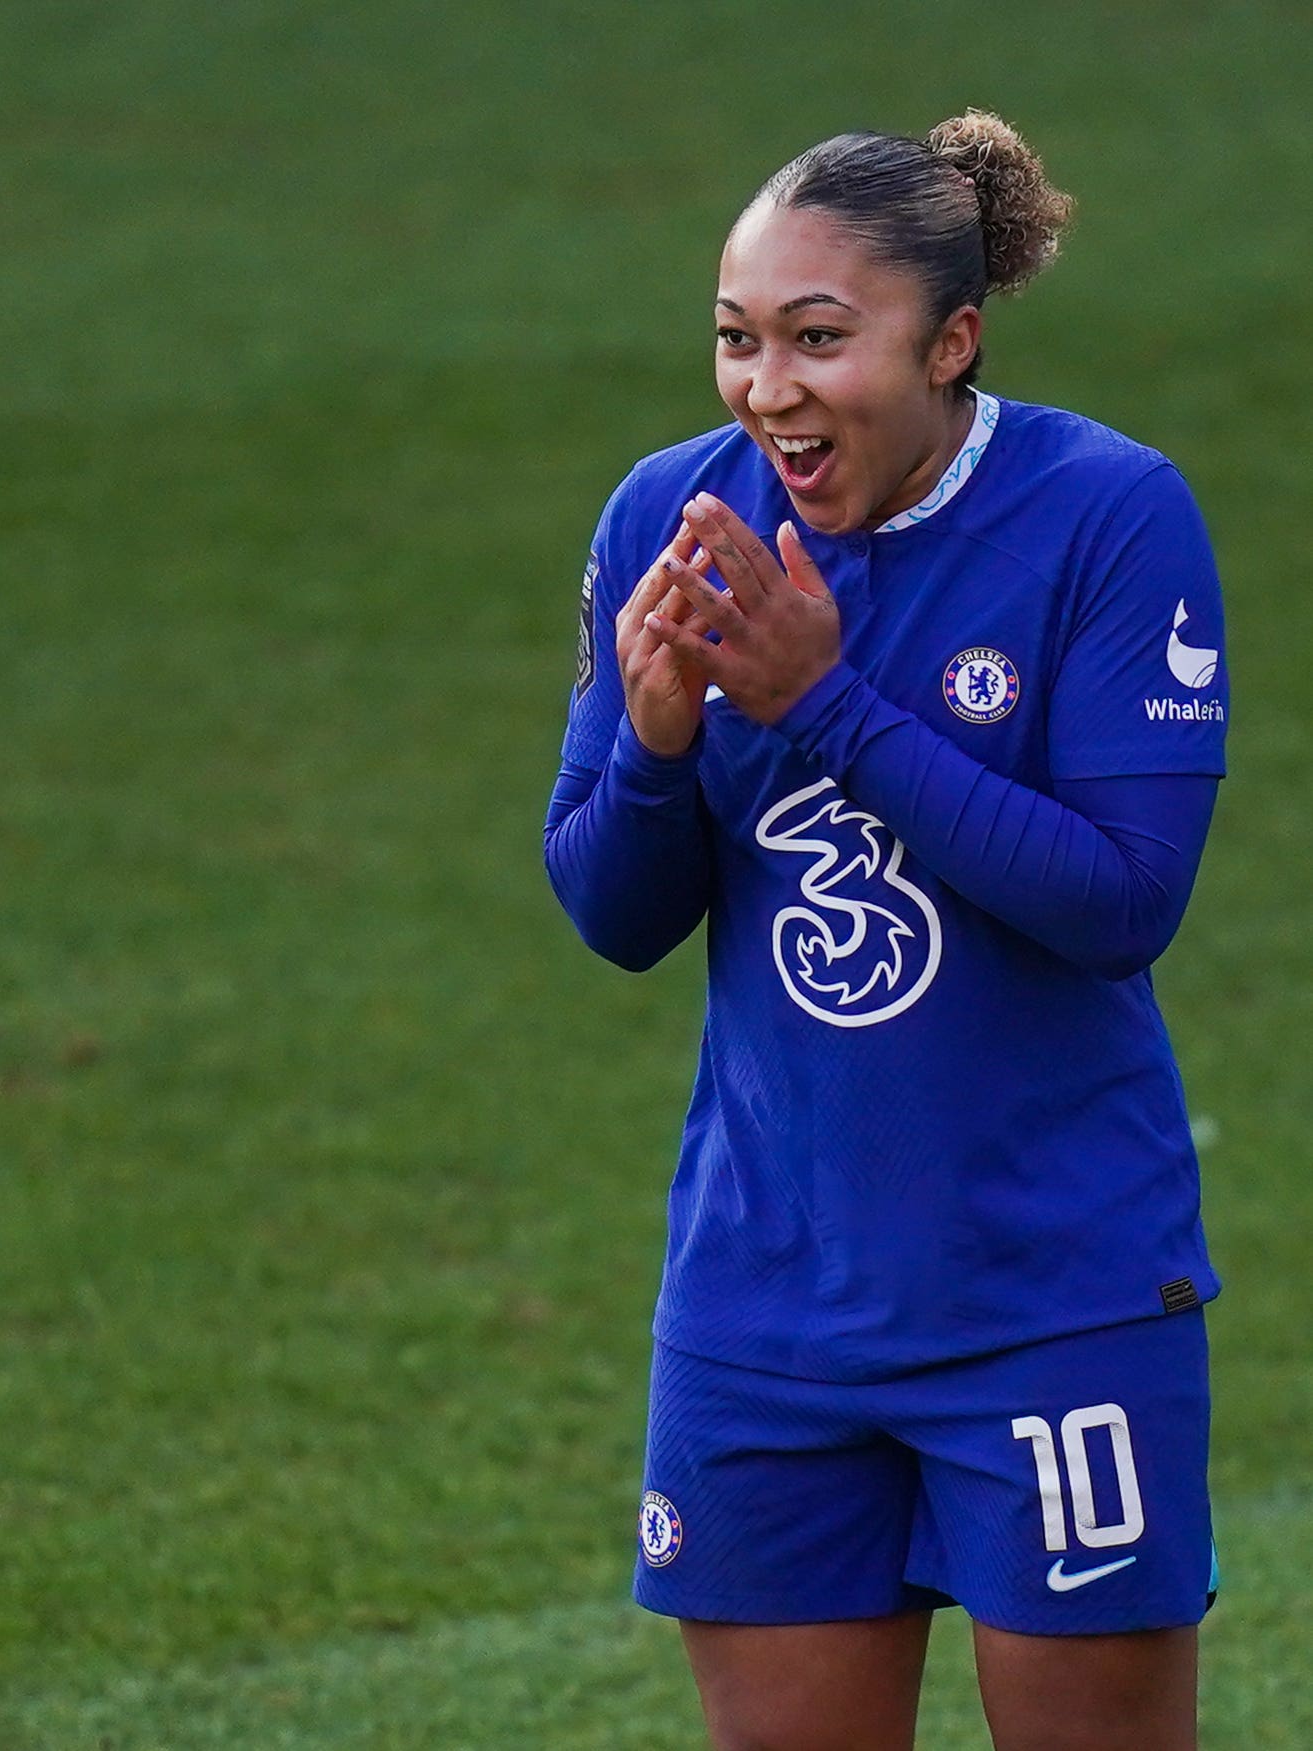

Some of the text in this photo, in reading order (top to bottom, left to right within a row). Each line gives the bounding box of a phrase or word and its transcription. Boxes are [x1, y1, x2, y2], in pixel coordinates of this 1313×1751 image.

[957, 650, 1007, 669] CHELSEA
[1144, 698, 1224, 722] Whalefin
[1011, 1403, 1145, 1551] 10
